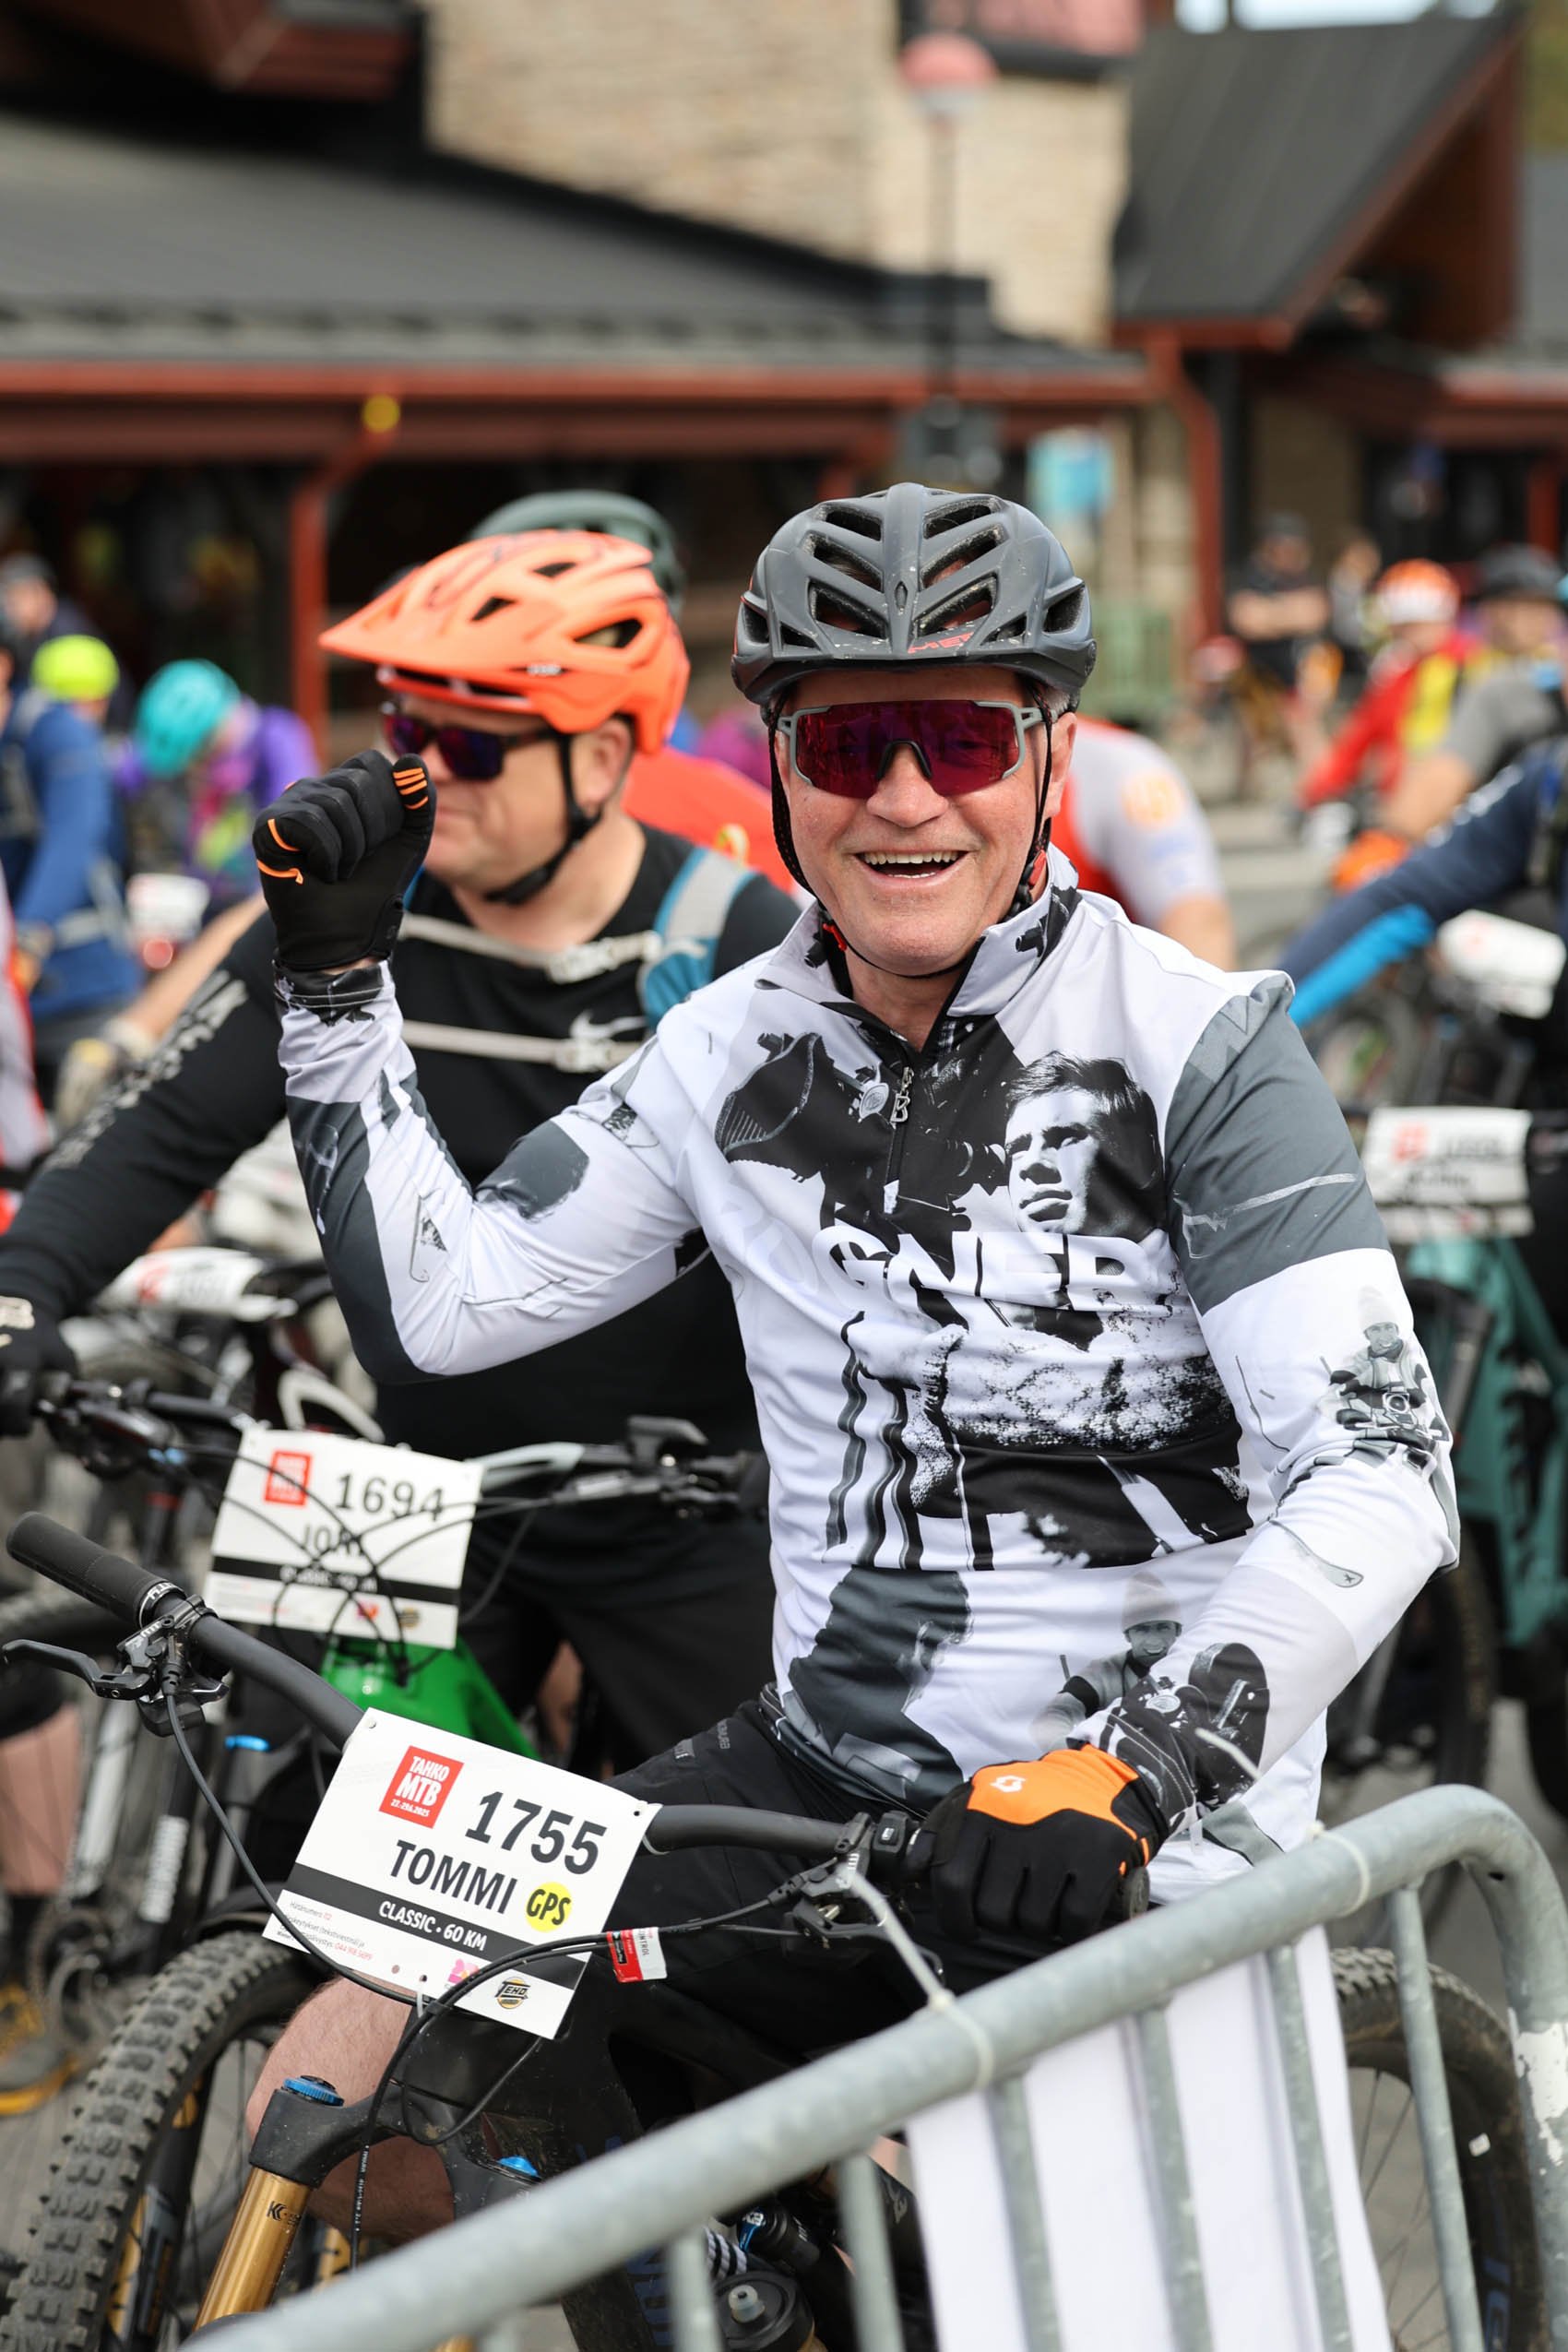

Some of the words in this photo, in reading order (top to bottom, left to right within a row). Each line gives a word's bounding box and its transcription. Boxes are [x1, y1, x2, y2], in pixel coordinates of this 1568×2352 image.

[336, 1473, 443, 1522] 1694
[395, 1772, 442, 1807] MTB
[410, 1755, 450, 1782] TAHKO
[465, 1791, 607, 1875] 1755
[390, 1839, 518, 1915] TOMMI
[378, 1900, 436, 1933] CLASSIC
[443, 1923, 465, 1942] 60
[462, 1929, 488, 1952] KM
[526, 1888, 572, 1926] GPS
